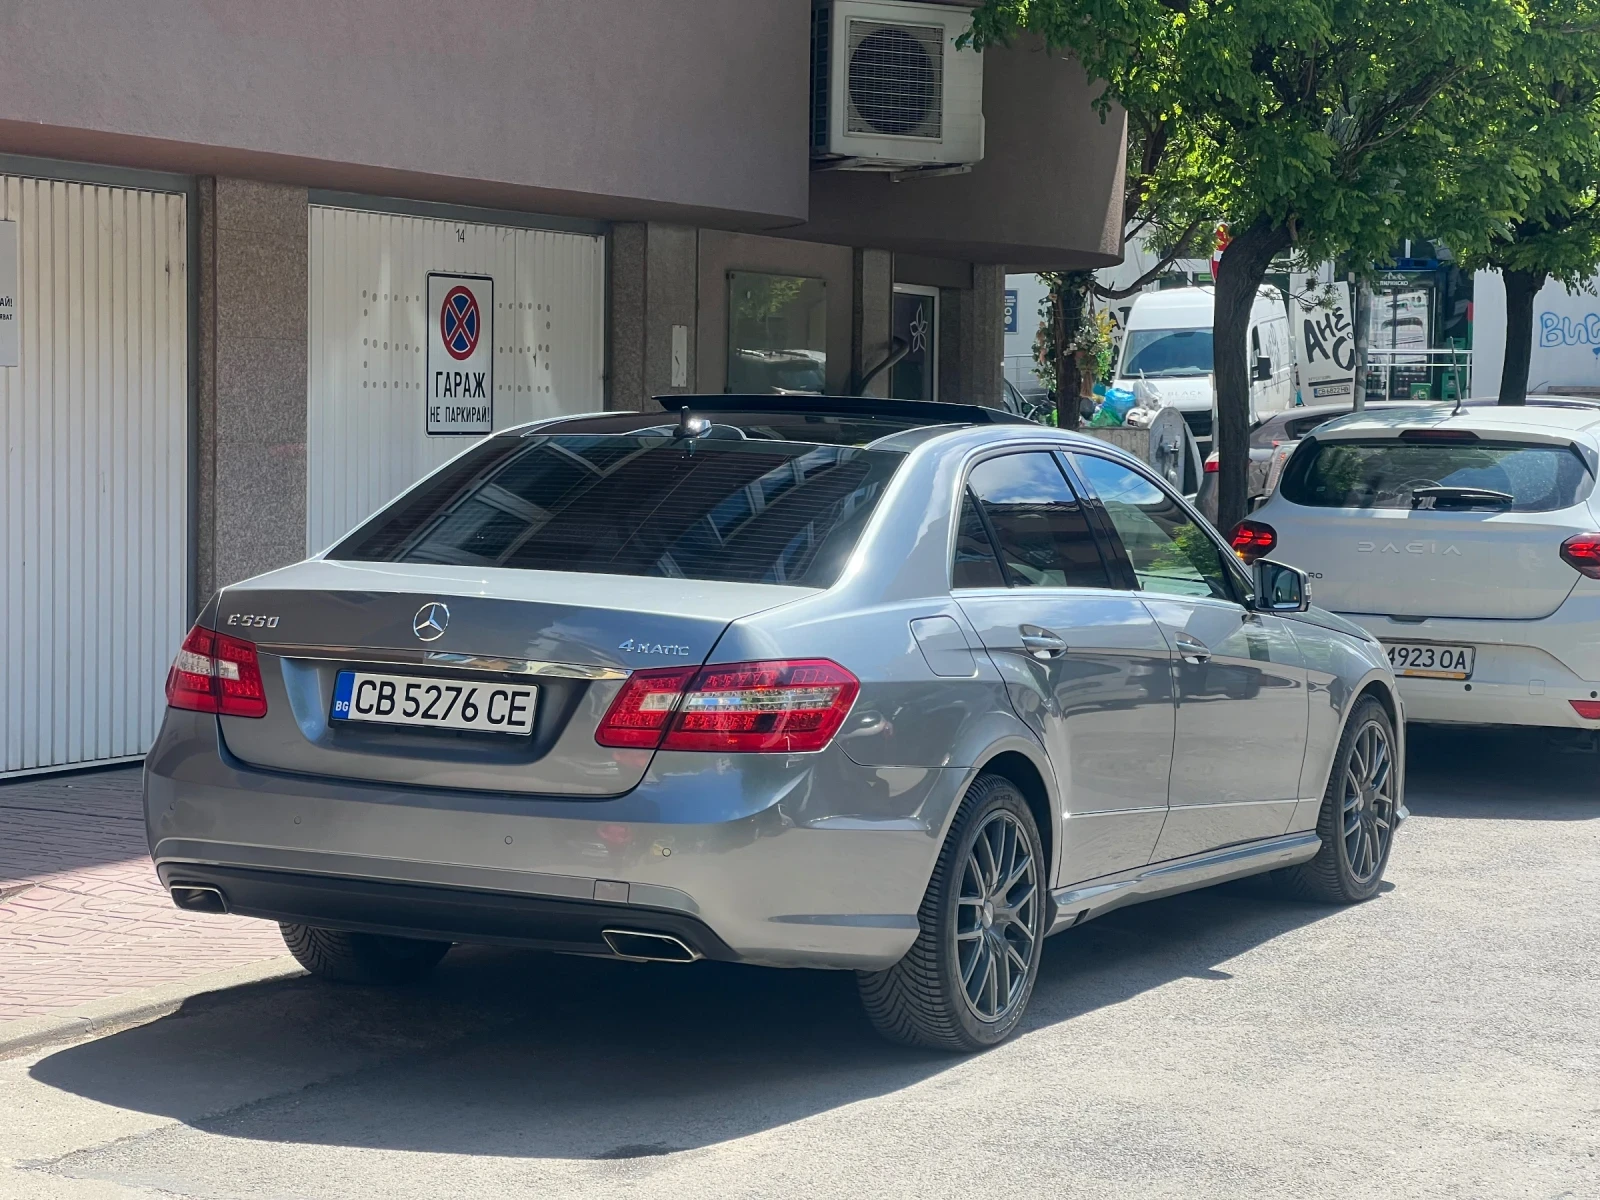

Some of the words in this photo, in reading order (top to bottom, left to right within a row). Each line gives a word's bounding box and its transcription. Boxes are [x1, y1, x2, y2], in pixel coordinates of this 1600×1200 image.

[455, 228, 465, 243] 14
[435, 371, 486, 398] ГАРАЖ
[430, 406, 441, 422] НЕ
[445, 405, 490, 423] ПАРКИРАЙ!
[1357, 540, 1463, 556] DACIA
[1440, 649, 1466, 670] OA
[335, 700, 349, 712] BG
[355, 679, 397, 716] CB
[402, 683, 479, 723] 5276
[486, 690, 531, 727] CE
